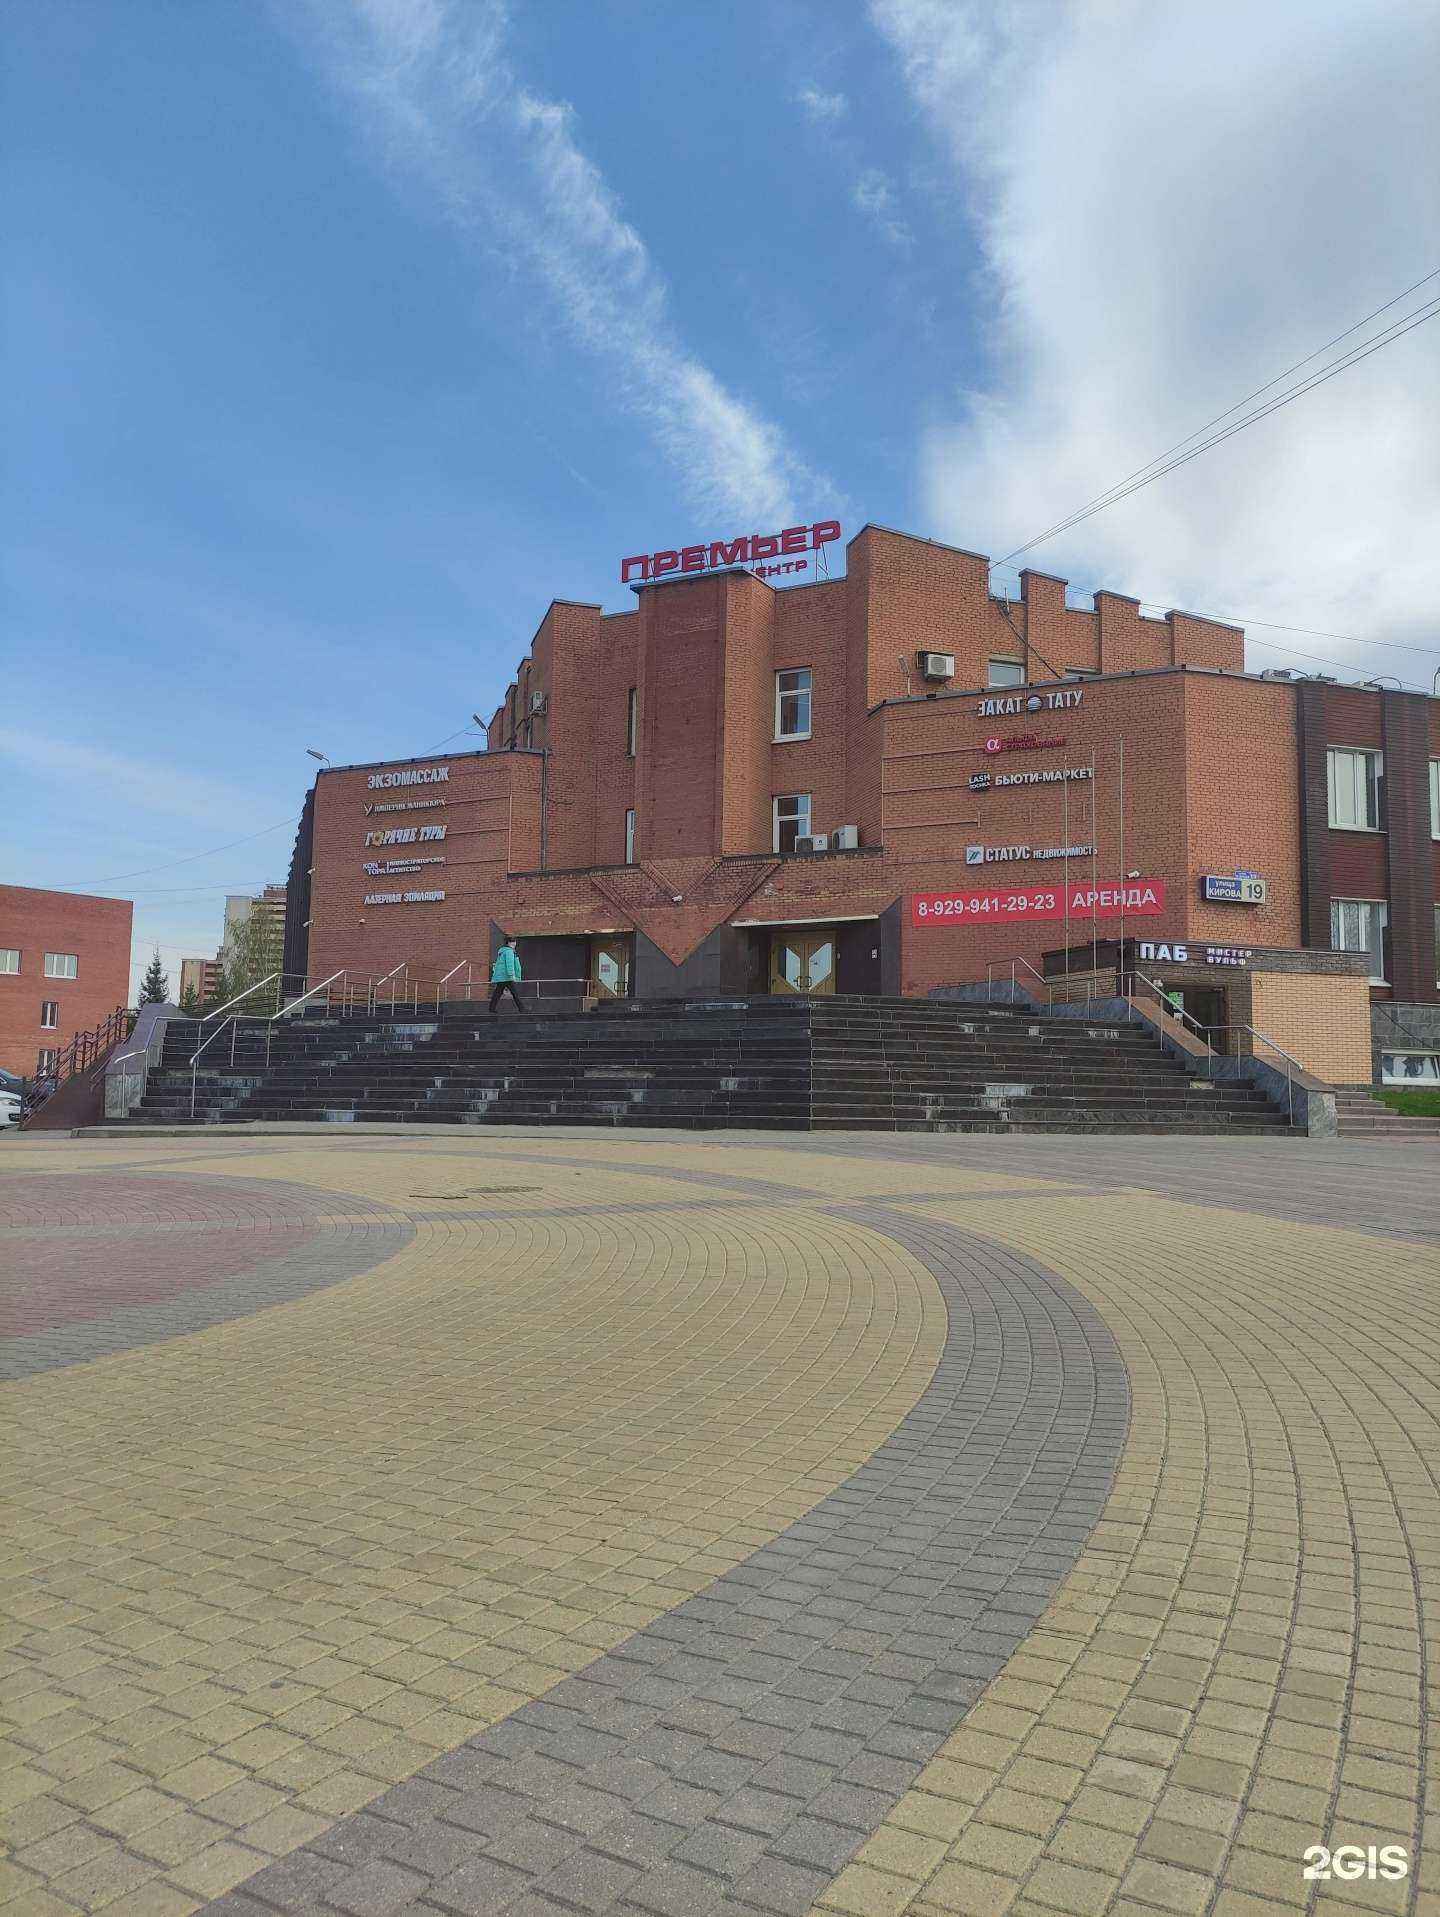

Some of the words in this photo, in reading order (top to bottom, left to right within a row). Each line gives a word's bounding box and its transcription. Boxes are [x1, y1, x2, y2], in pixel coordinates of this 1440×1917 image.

[621, 520, 841, 583] ПРЕМЬЕР
[752, 560, 807, 578] ЕНТР
[978, 697, 1022, 716] ЗАКАТ
[1046, 690, 1083, 709] ТАТУ
[367, 767, 449, 789] ЭКЗОМАССАЖ
[995, 767, 1092, 786] БЬЮТИ-МАРКЕТ
[985, 846, 1030, 862] СТАТУС
[1033, 846, 1098, 859] НЕДВИЖИМОСТЬ
[1209, 887, 1241, 898] КИРОВА
[1247, 883, 1263, 899] 19
[918, 894, 1056, 917] 8-929-941-29-23
[1071, 888, 1157, 908] АРЕНДА
[1140, 943, 1188, 962] ПАБ
